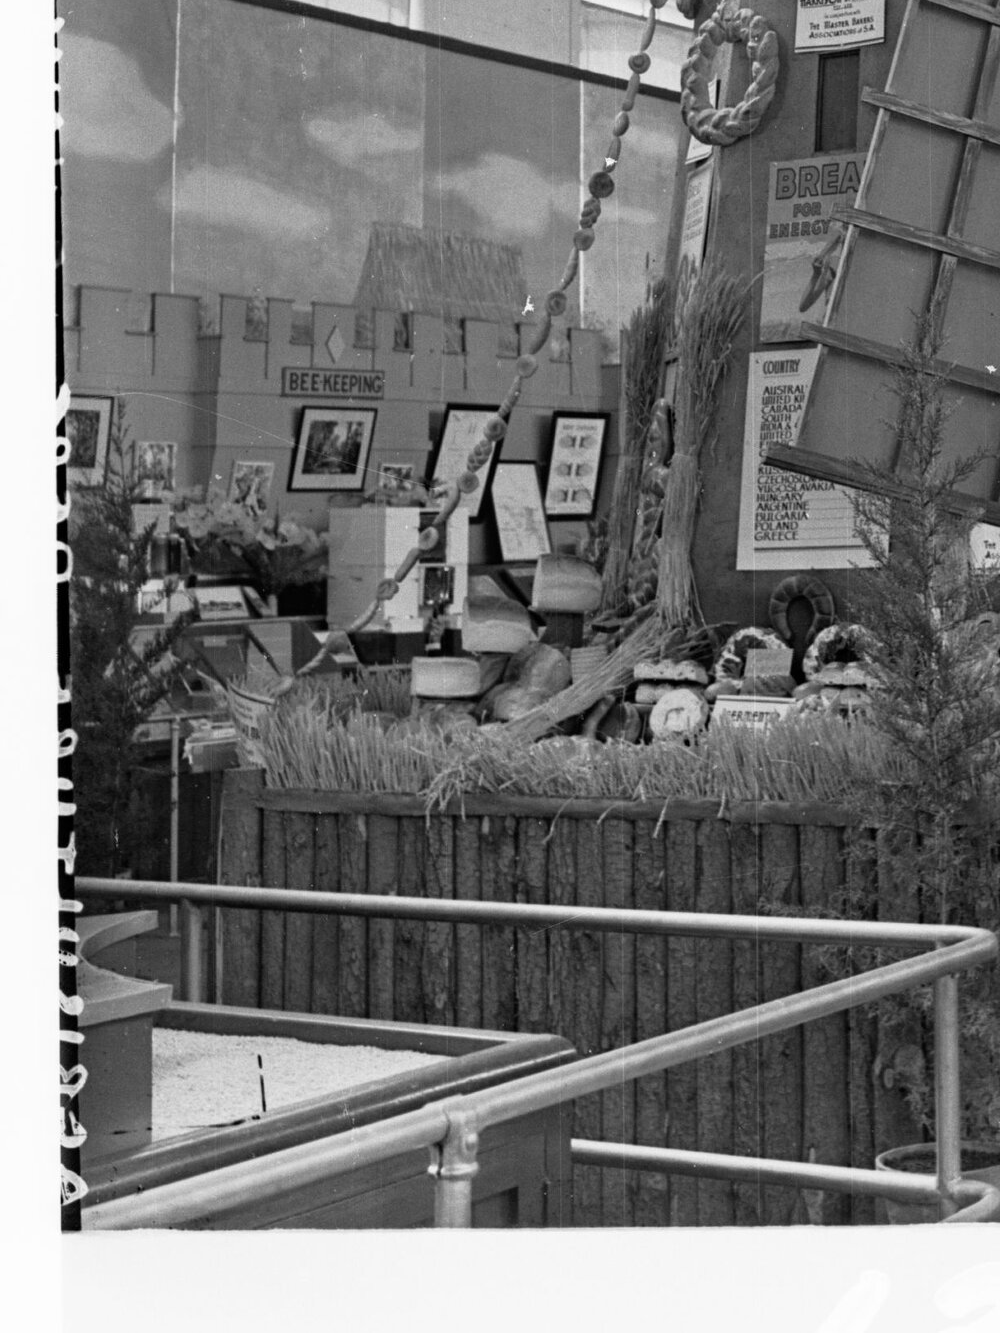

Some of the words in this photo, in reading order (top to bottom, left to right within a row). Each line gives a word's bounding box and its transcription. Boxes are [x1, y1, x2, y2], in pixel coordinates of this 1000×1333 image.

[775, 161, 867, 200] BREA
[793, 202, 822, 218] FOR
[769, 219, 831, 239] ENERGY
[763, 359, 800, 375] COUNTRY
[289, 372, 382, 393] BEE-KEEPING
[763, 384, 808, 395] AUSTRAL
[762, 414, 791, 423] SOUTH
[756, 492, 805, 502] HUNGARY
[755, 521, 799, 532] POLAND
[754, 531, 799, 541] GREECE
